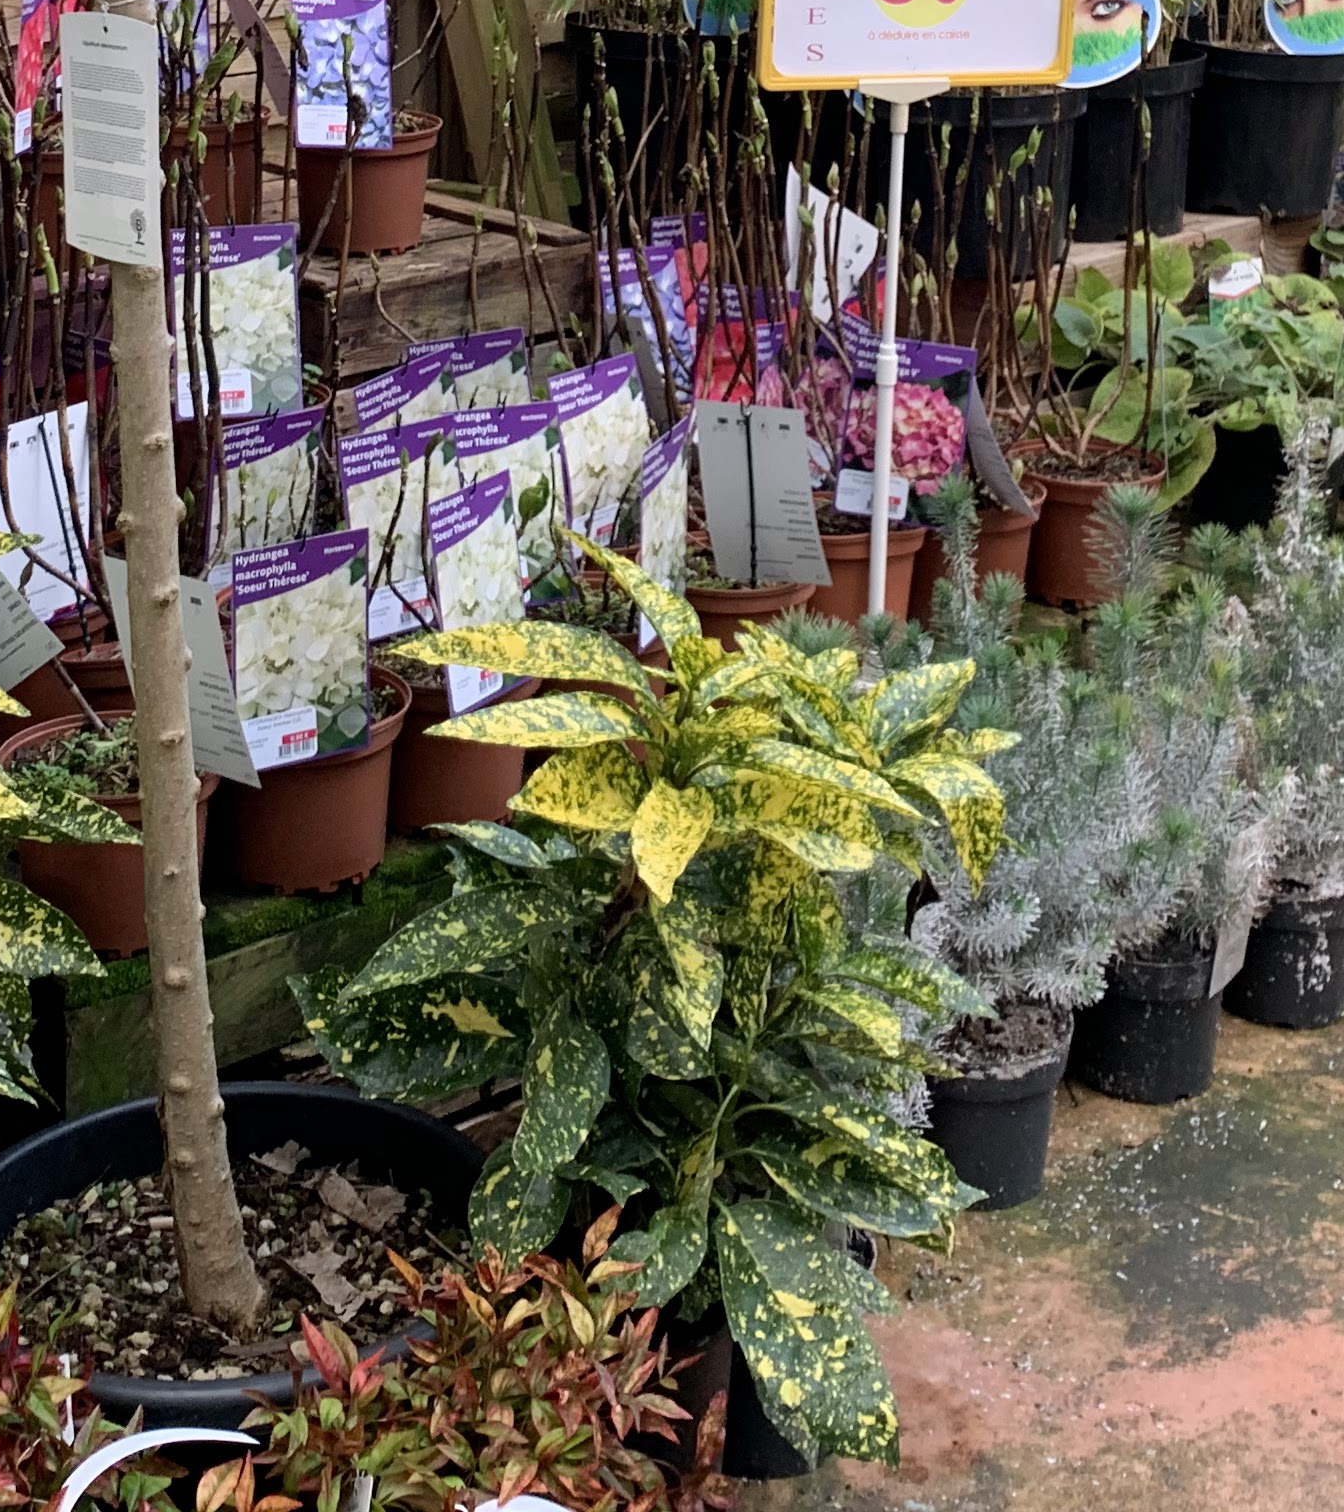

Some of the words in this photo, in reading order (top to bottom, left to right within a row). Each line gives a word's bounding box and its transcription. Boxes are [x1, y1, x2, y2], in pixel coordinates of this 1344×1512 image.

[355, 375, 394, 398] Hydrangea
[454, 412, 491, 423] drangea
[223, 424, 260, 441] ydrangea
[341, 433, 388, 451] Hydrangea
[342, 445, 396, 464] macrophylla
[372, 456, 400, 470] Théres
[235, 548, 289, 567] Hydrangea
[235, 561, 297, 582] macrophylla
[235, 582, 267, 595] 'Soeur
